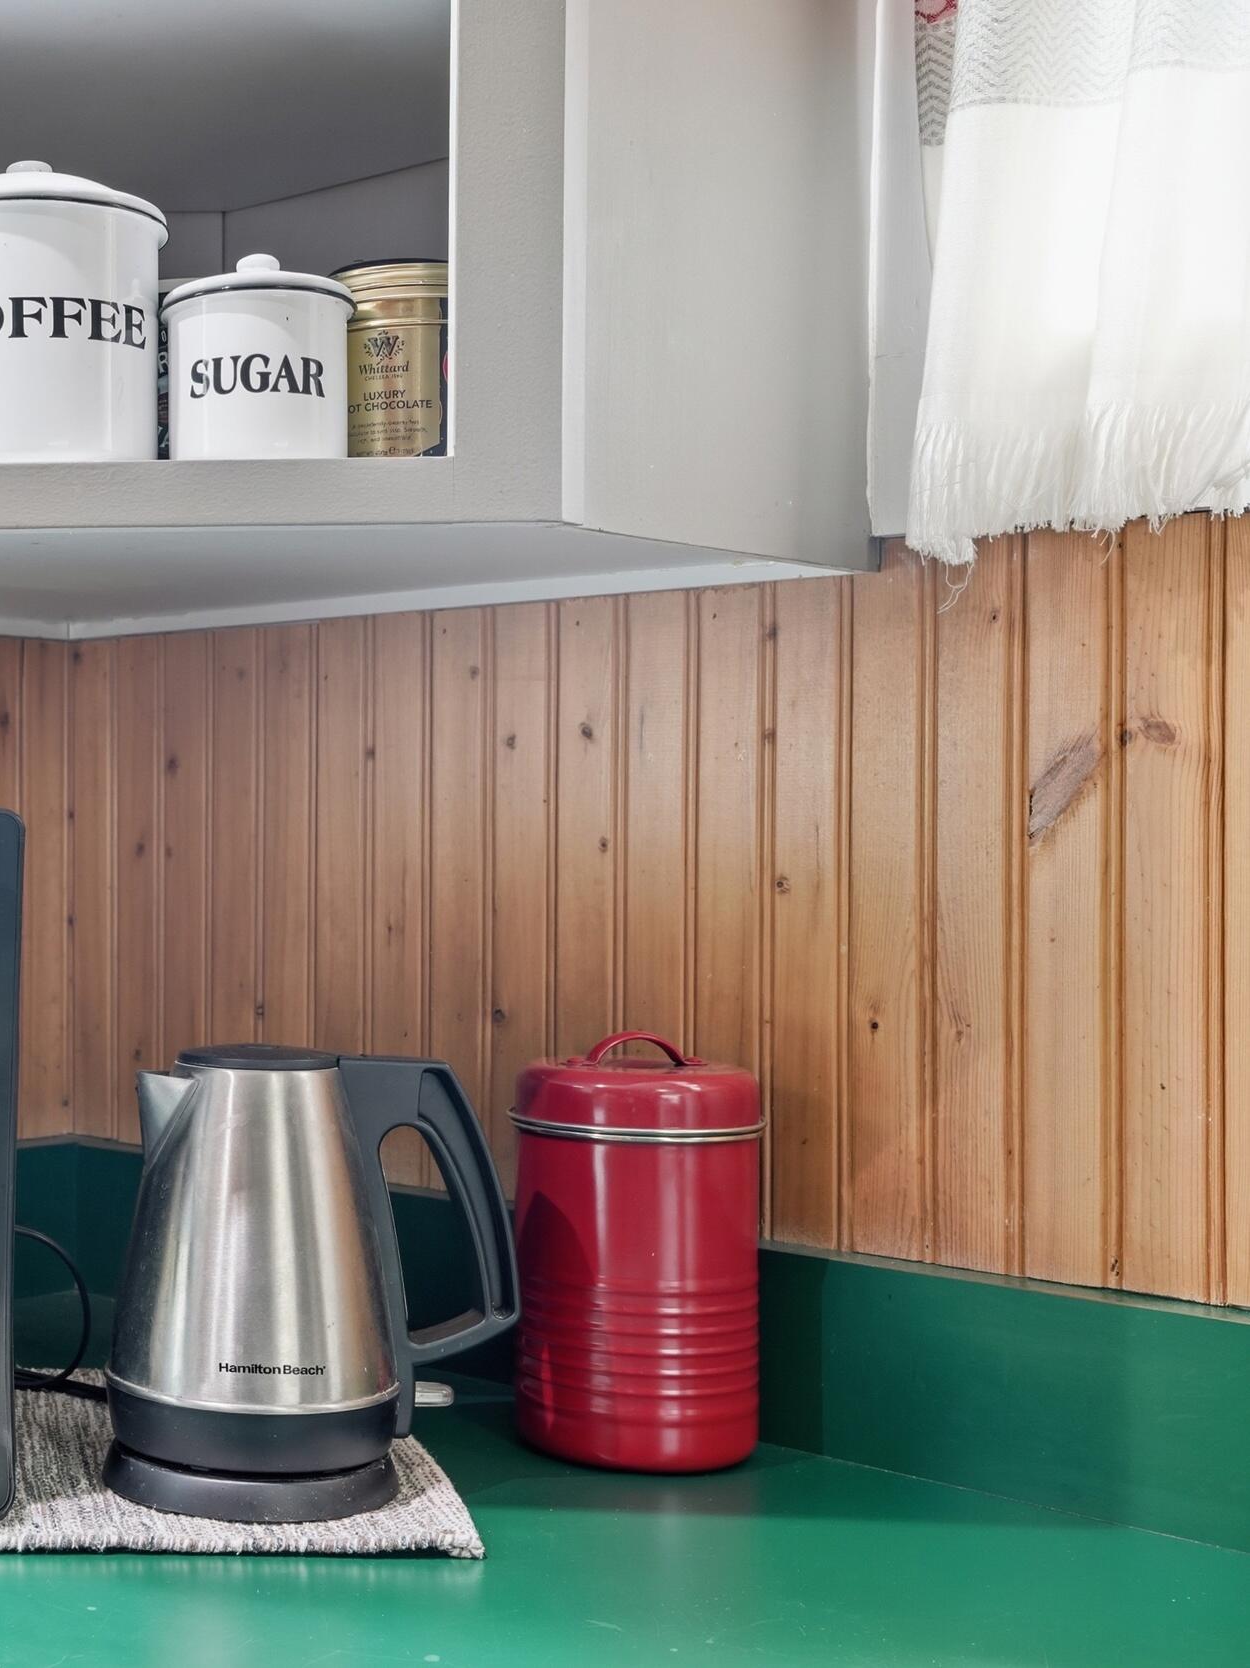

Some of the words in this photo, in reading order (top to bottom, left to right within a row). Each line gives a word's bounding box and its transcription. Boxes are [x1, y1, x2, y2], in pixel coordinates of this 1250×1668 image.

[358, 361, 410, 376] Whittard
[190, 354, 325, 398] SUGAR
[363, 390, 406, 402] LUXURY
[348, 404, 362, 414] OT
[365, 400, 433, 412] CHOCOLATE
[219, 1363, 281, 1374] Hamilton
[283, 1365, 324, 1375] Beach
